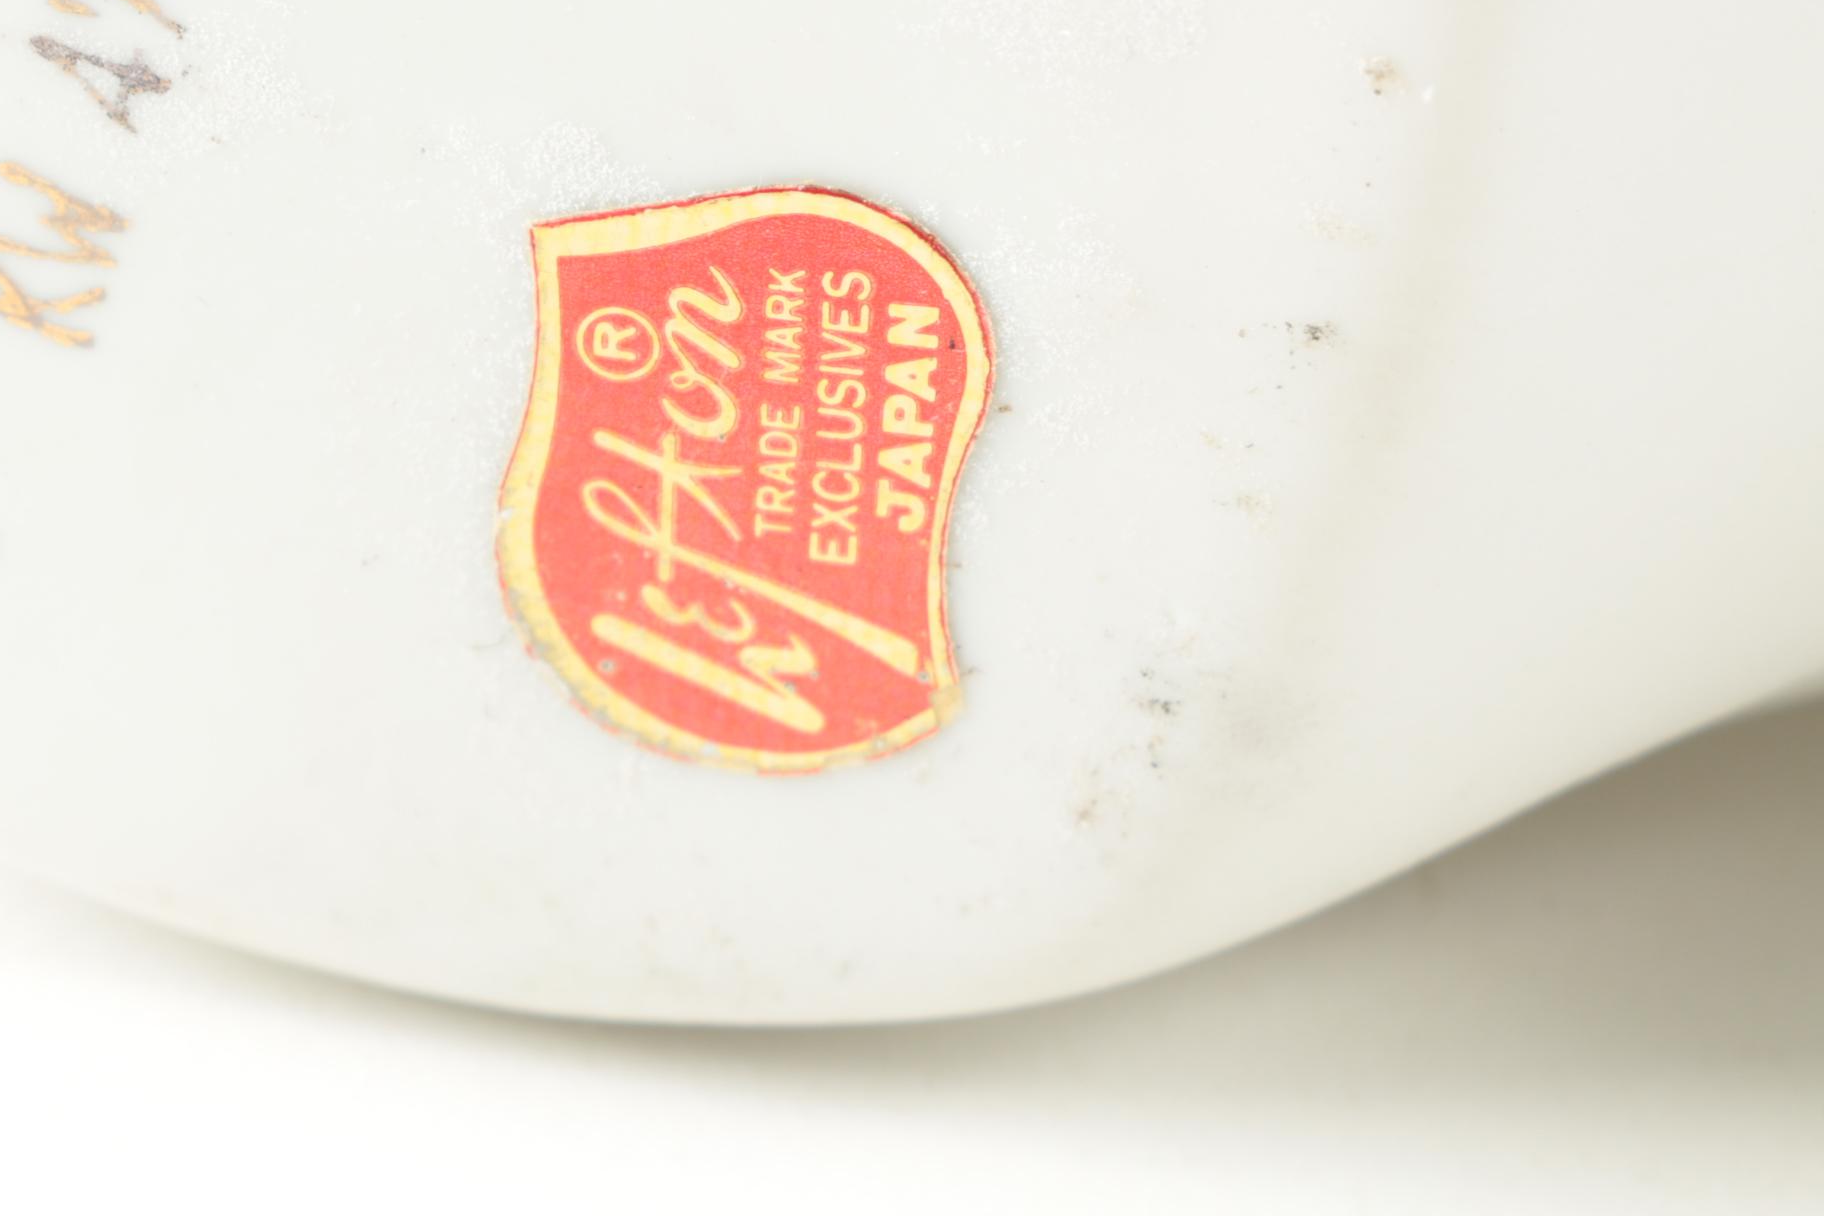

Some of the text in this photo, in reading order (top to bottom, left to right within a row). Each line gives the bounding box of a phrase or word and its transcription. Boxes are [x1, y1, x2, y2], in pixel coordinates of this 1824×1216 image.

[583, 265, 920, 734] Lefton
[754, 266, 808, 538] TRADE MARK
[808, 269, 874, 566] EXCLUSIVES
[876, 303, 941, 534] JAPAN
